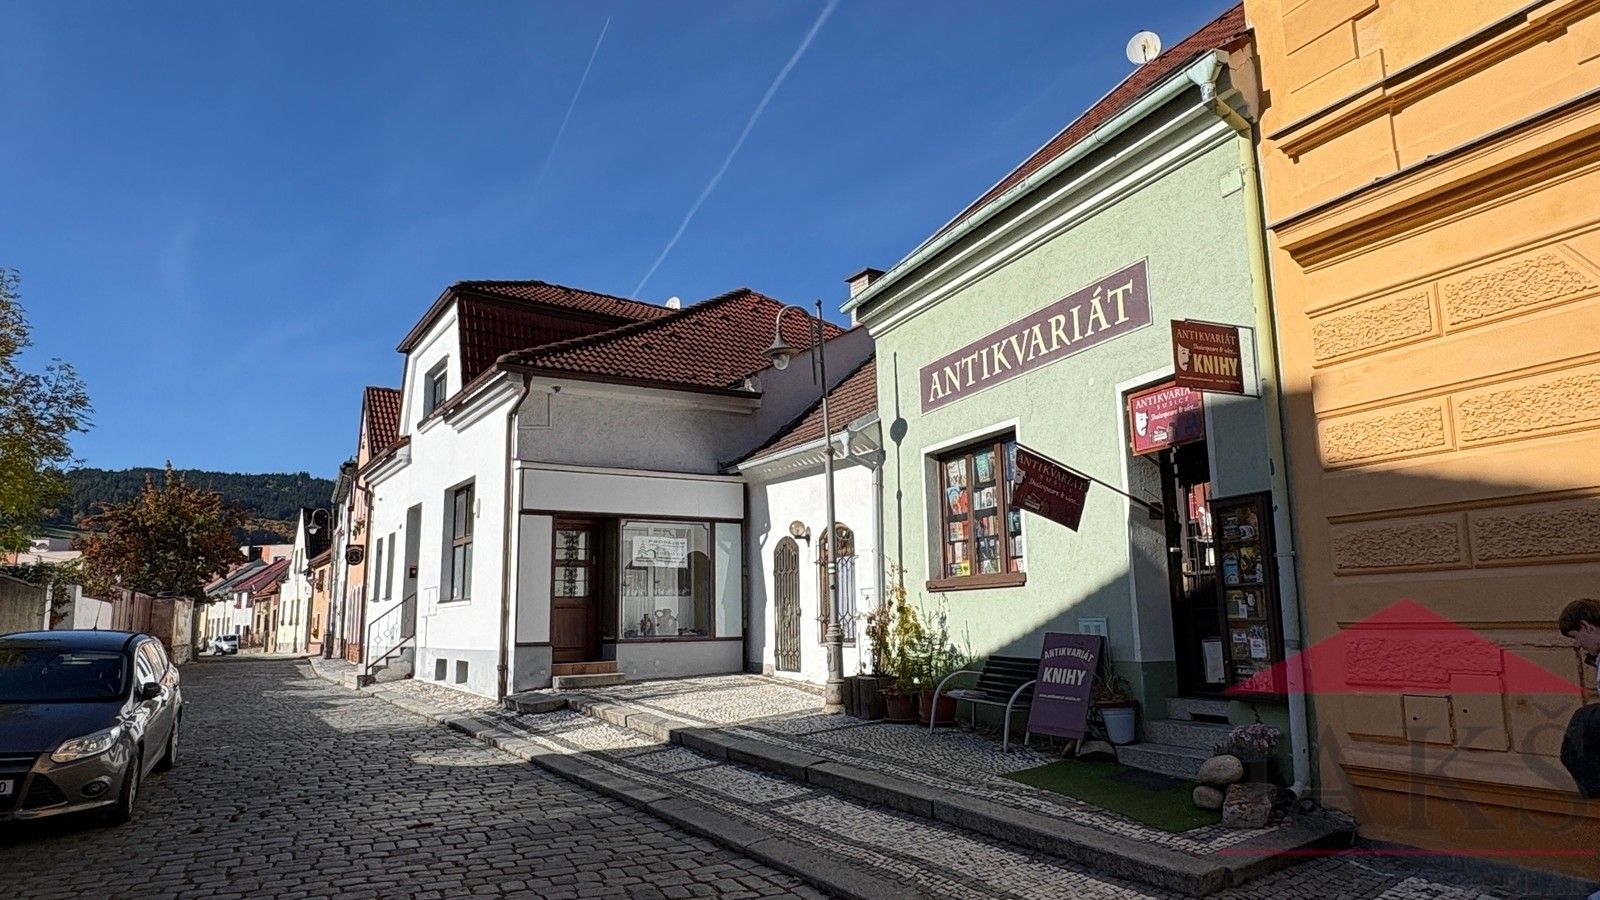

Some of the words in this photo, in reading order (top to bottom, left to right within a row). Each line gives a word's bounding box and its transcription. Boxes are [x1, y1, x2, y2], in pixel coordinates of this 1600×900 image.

[928, 279, 1133, 403] ANTIKVARIÁT
[1176, 328, 1237, 345] ANTIKVARIÁT
[1193, 353, 1238, 377] KNIHY
[1044, 647, 1094, 663] ANTIKVARIÁT
[1042, 667, 1087, 686] KNIHY
